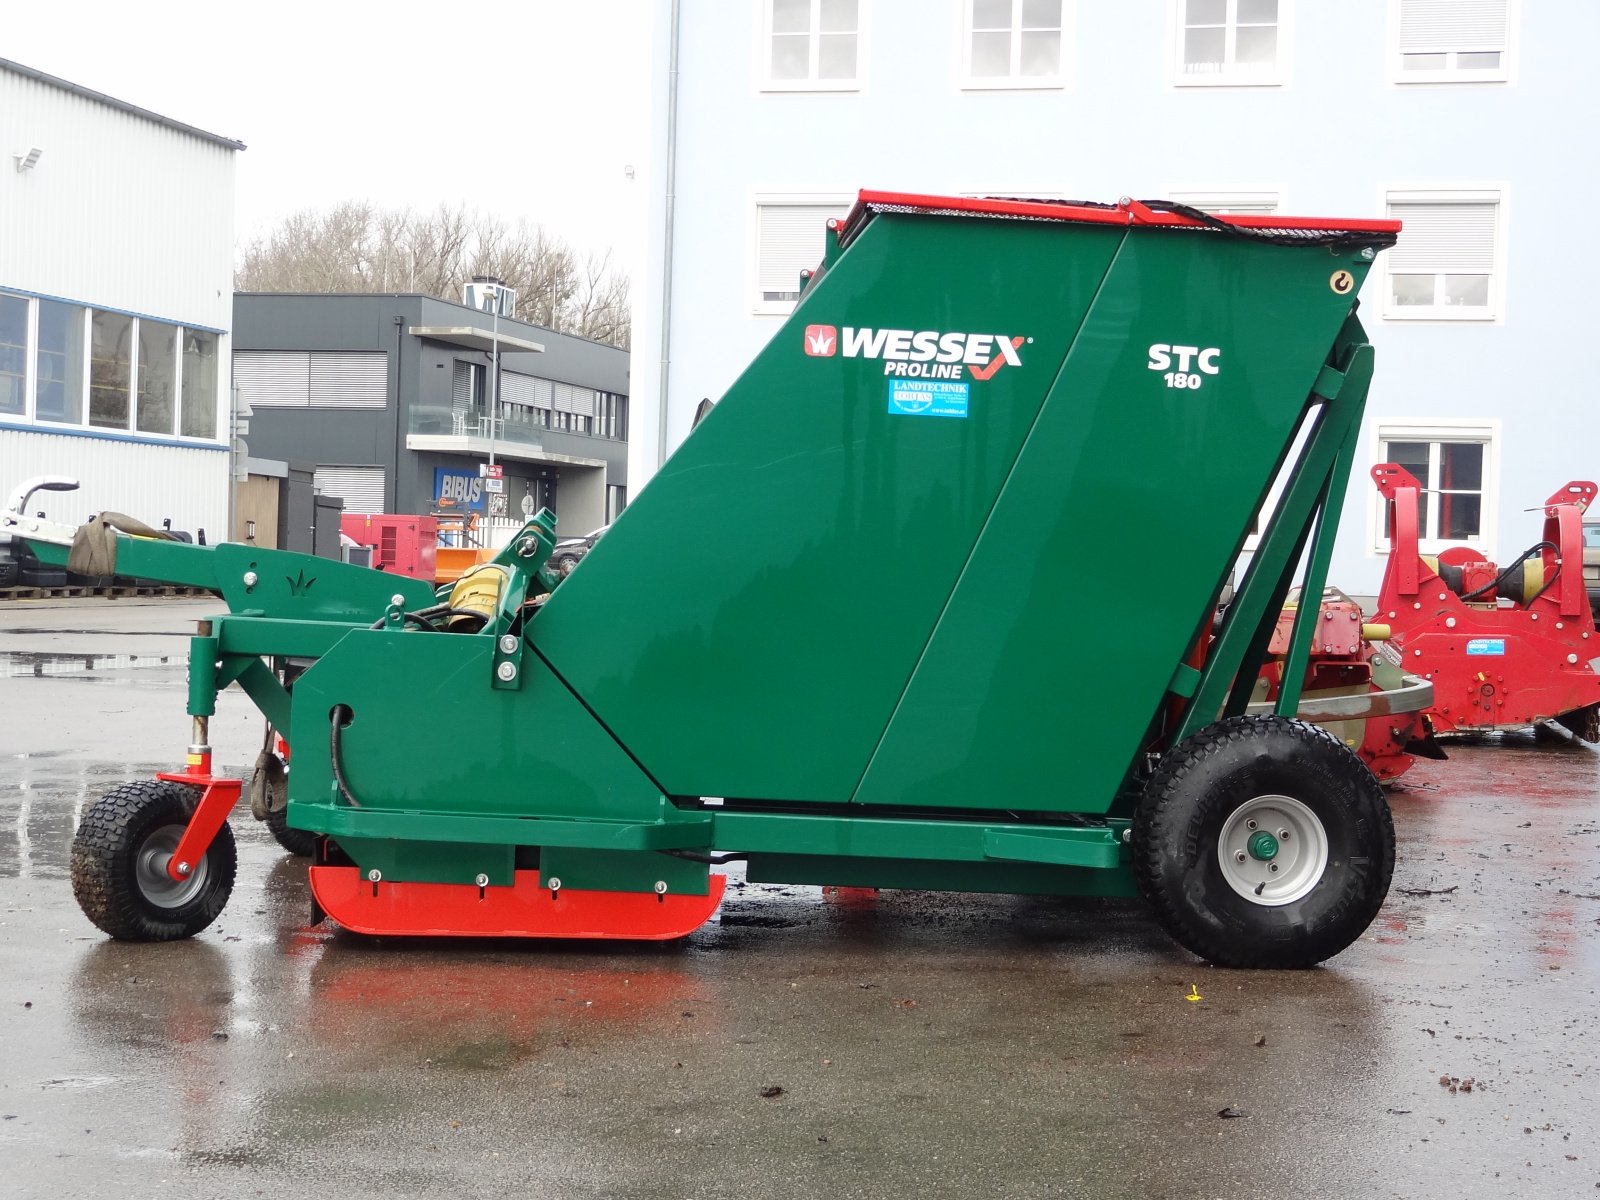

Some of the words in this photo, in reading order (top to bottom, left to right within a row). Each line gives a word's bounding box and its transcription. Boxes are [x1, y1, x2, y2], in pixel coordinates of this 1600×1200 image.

[842, 327, 1024, 380] WESSEX
[1148, 344, 1220, 374] STC
[884, 362, 962, 379] PROLINE
[1164, 373, 1201, 389] 180
[894, 381, 967, 393] LANDTECHNIK
[442, 475, 480, 502] BIBUS
